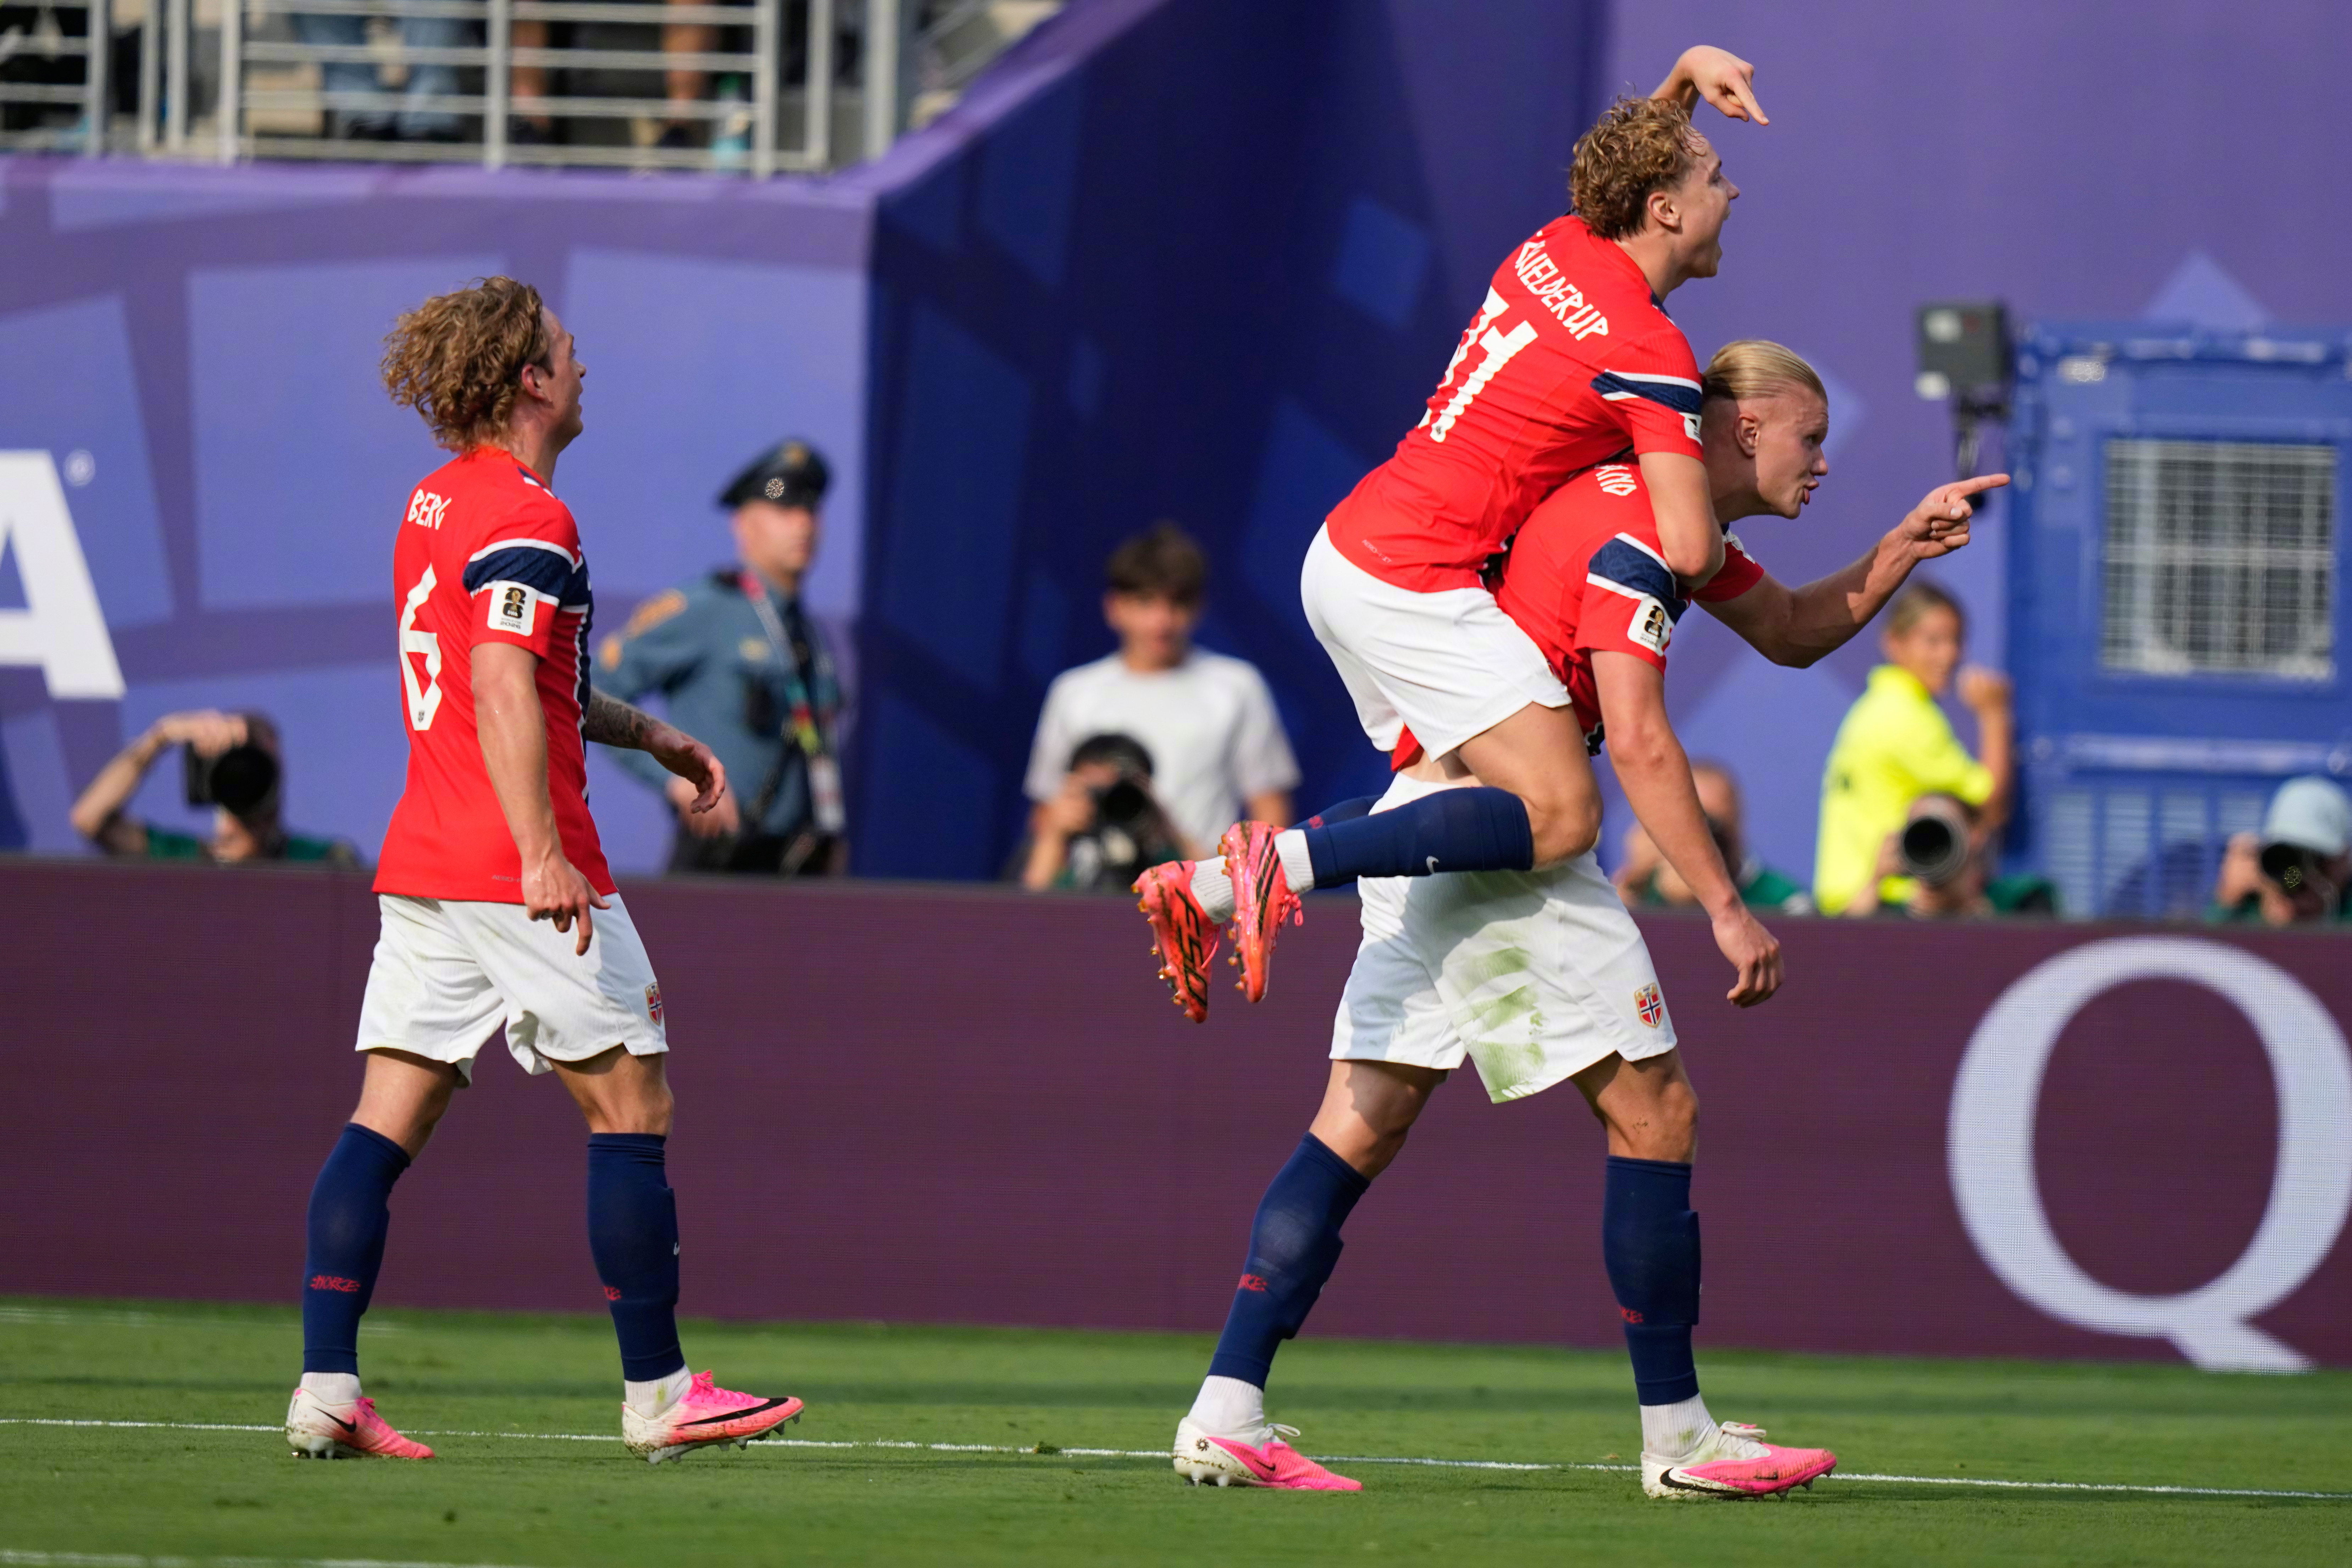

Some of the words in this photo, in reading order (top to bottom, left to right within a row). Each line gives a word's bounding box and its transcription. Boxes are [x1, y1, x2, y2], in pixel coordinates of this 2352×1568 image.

[407, 488, 452, 530] BERG
[399, 563, 442, 731] 6
[1945, 934, 2352, 1375] Q
